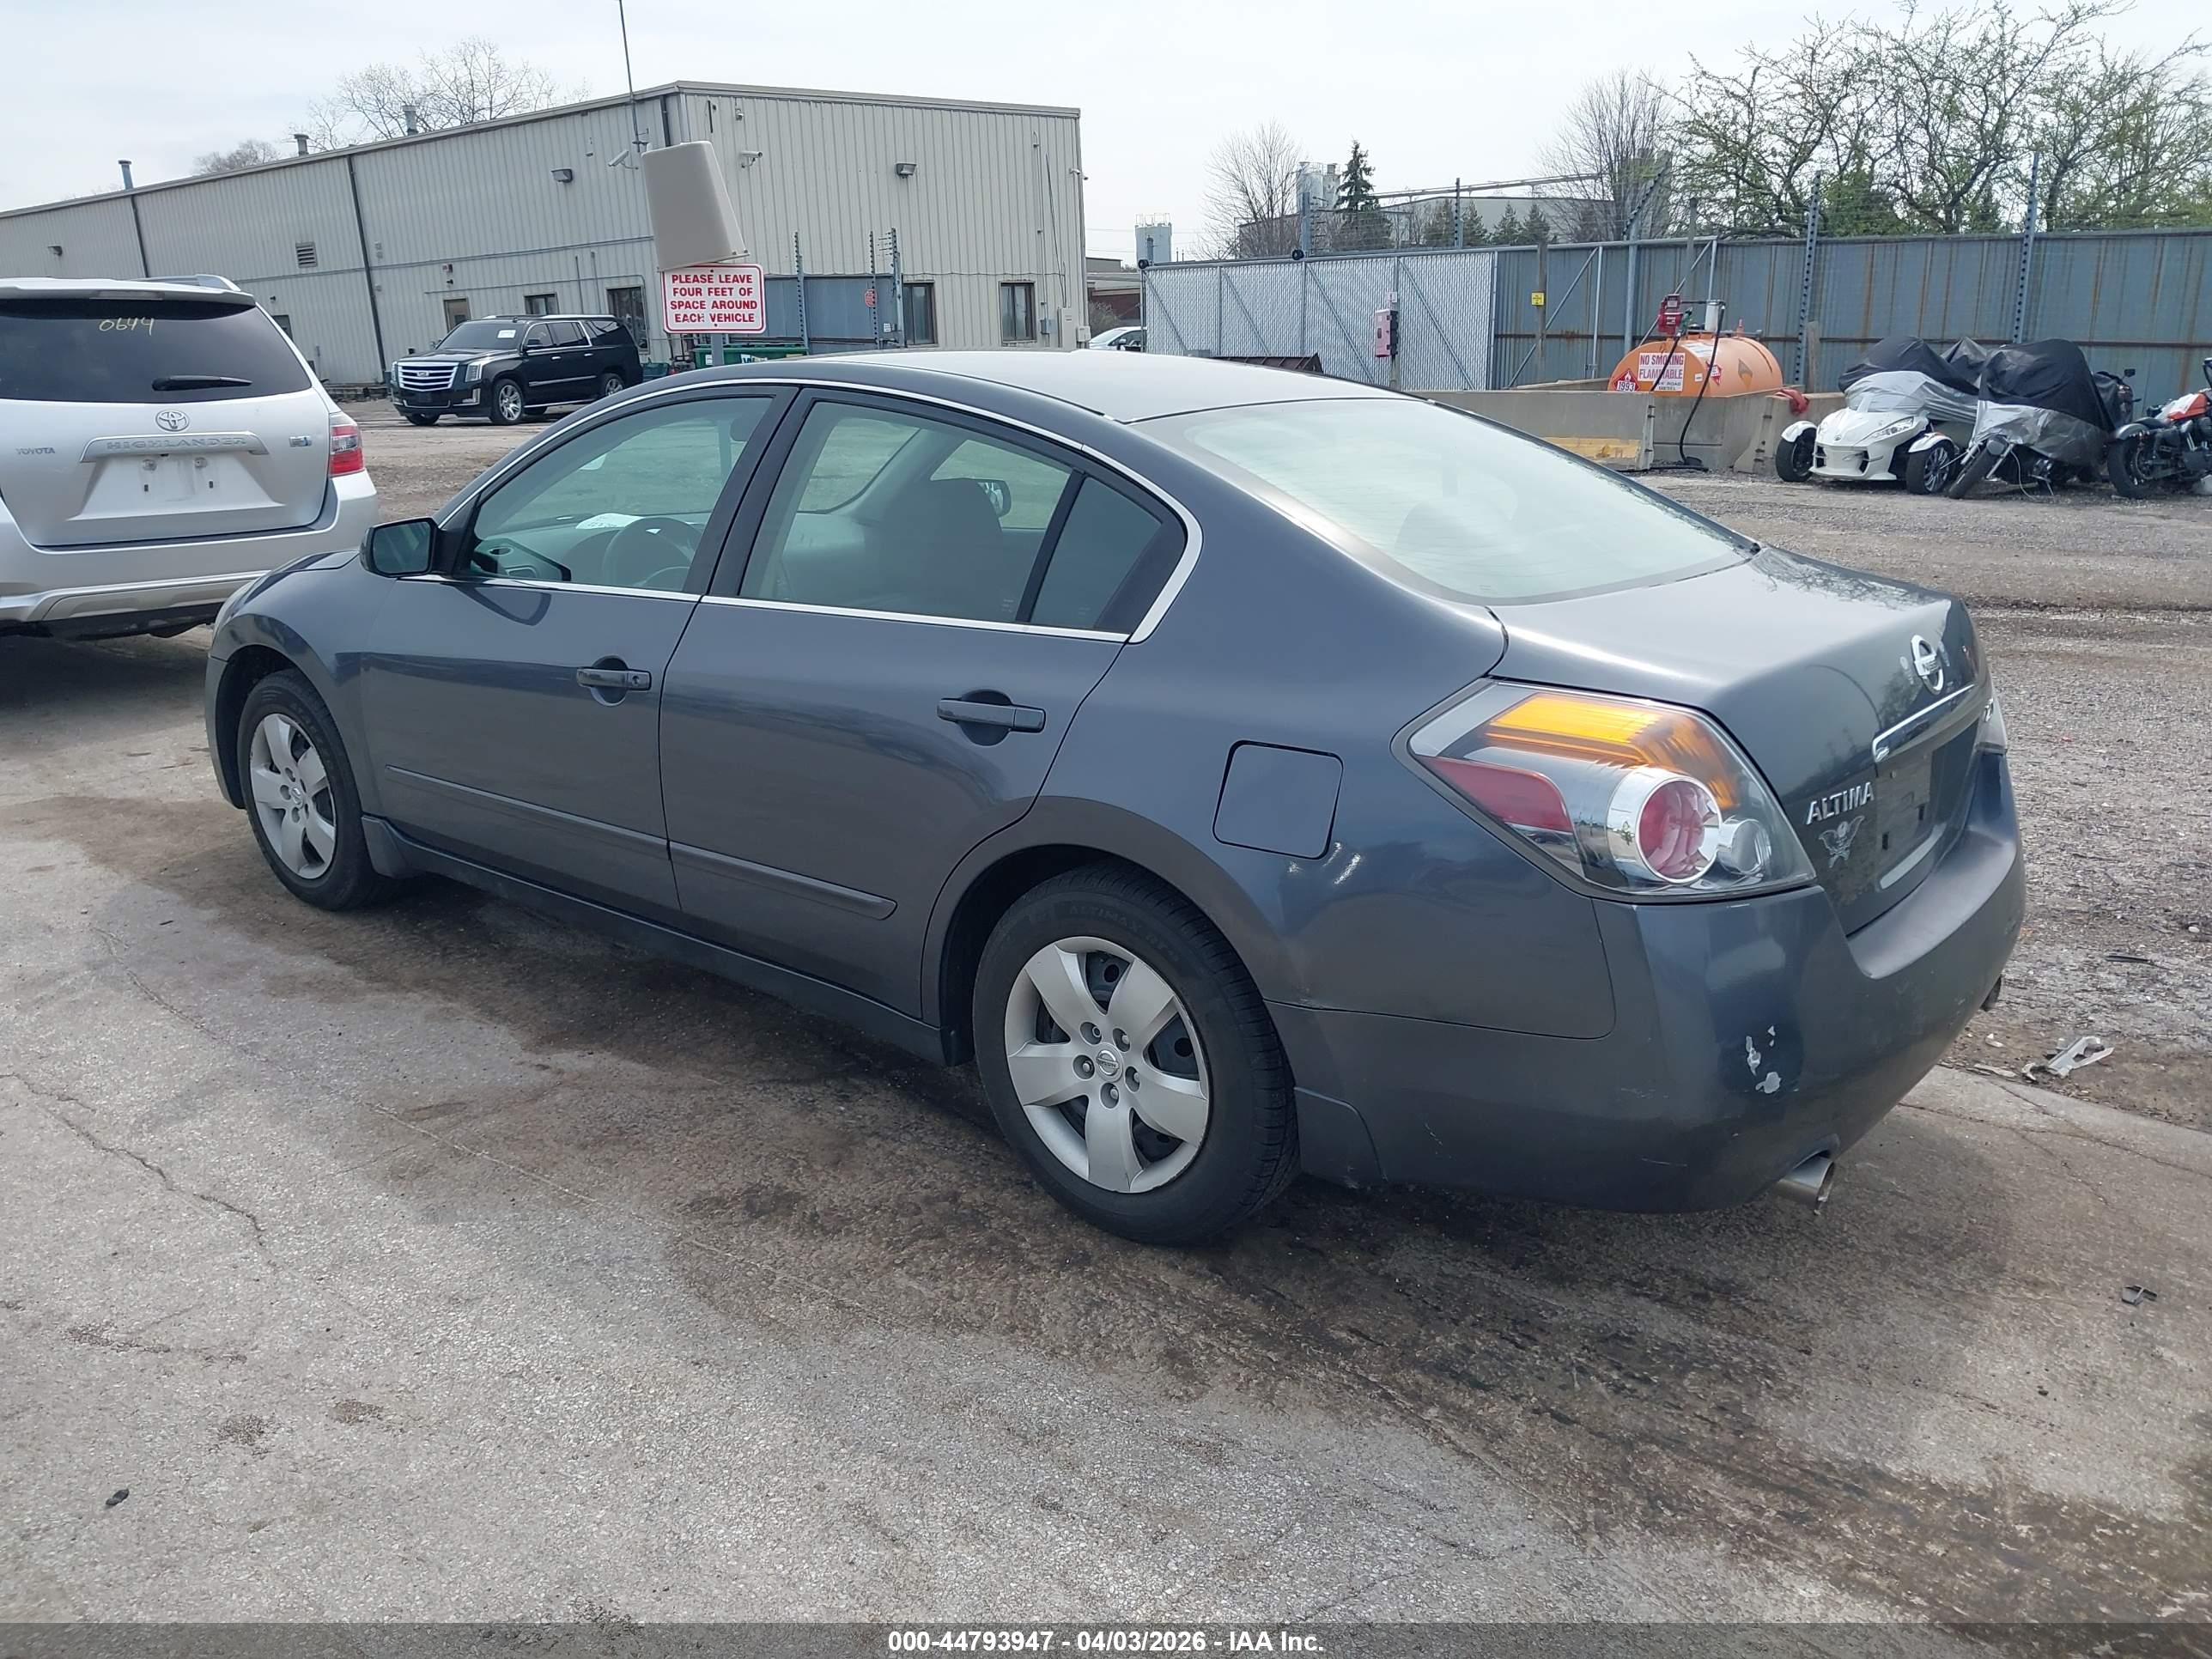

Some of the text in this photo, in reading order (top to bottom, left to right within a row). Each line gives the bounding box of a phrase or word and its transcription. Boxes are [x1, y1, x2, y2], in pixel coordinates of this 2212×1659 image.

[672, 274, 753, 283] PLEASE LEAVE
[672, 287, 753, 296] FOUR FEET OF
[670, 301, 757, 310] SPACE AROUND
[674, 313, 755, 323] EACH VEHICLE
[99, 318, 155, 336] 0644
[1640, 355, 1650, 366] NO
[1619, 381, 1635, 392] 1993
[106, 437, 246, 450] HIGHLANDER
[15, 447, 56, 455] TOYOTA
[1806, 781, 1875, 825] ALTIMA
